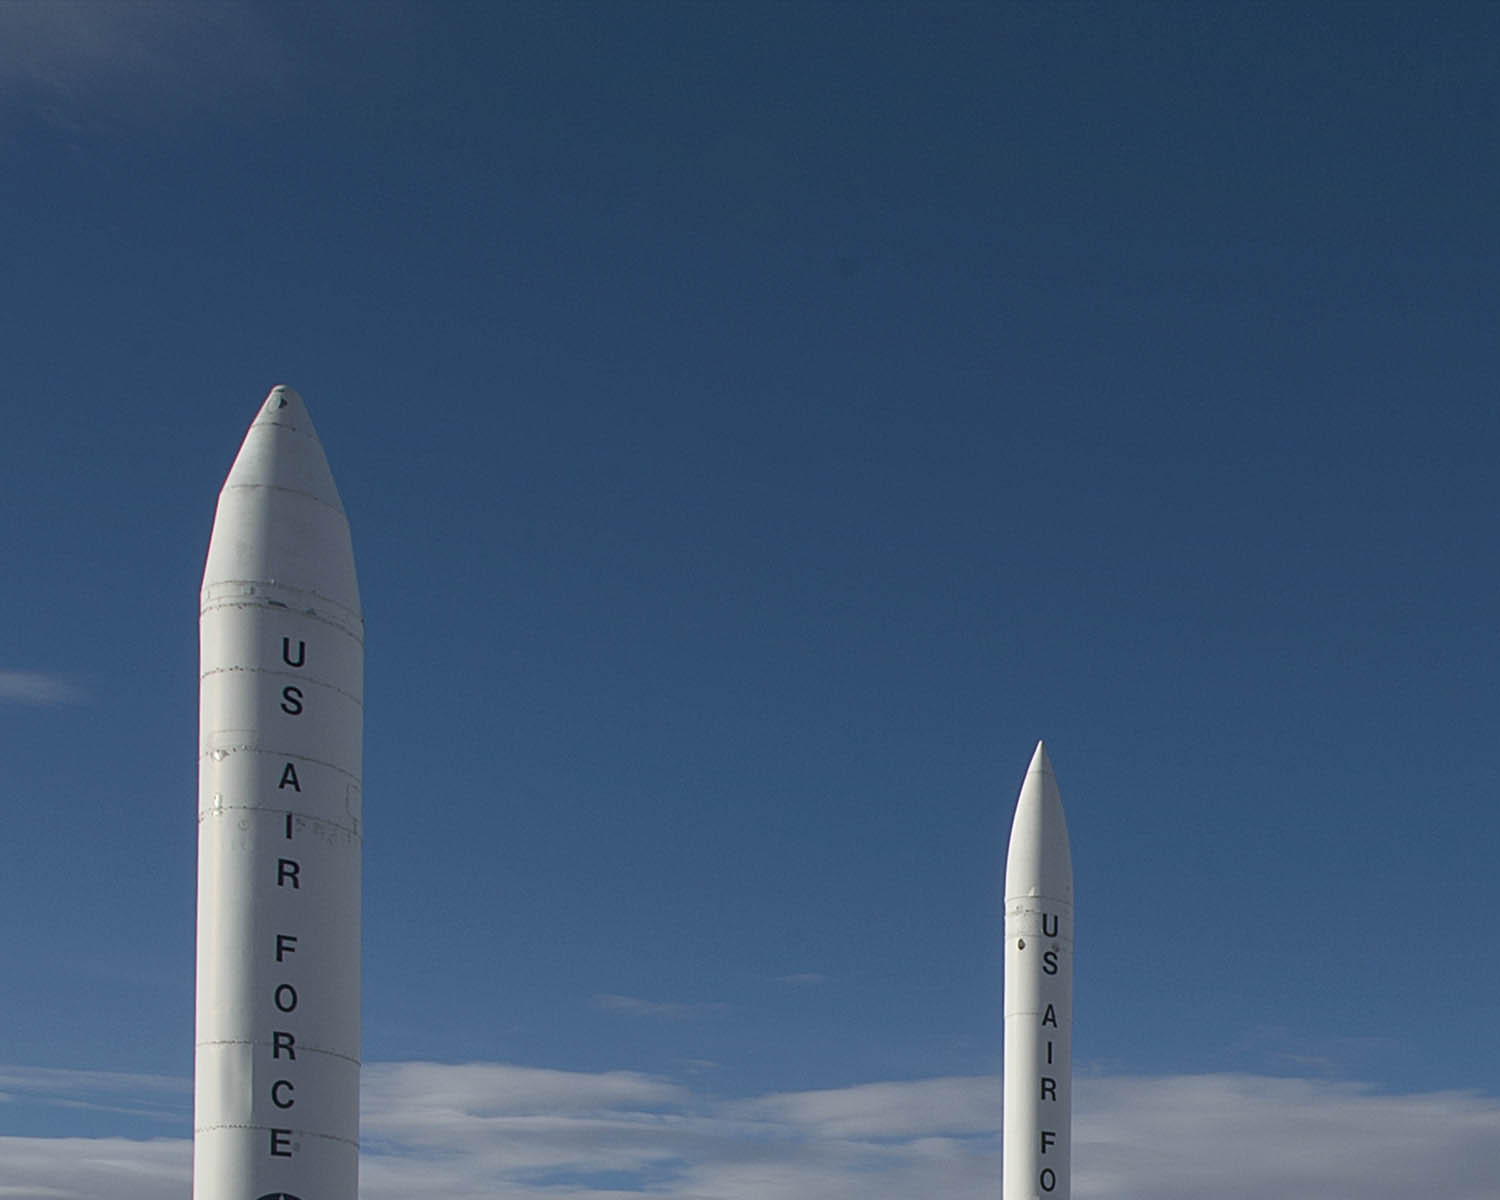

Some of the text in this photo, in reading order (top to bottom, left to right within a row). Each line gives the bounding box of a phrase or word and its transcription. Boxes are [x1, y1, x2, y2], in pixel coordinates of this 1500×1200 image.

[270, 637, 306, 1158] US AIR FORCE
[1042, 912, 1059, 976] US
[1041, 1003, 1058, 1103] AIR
